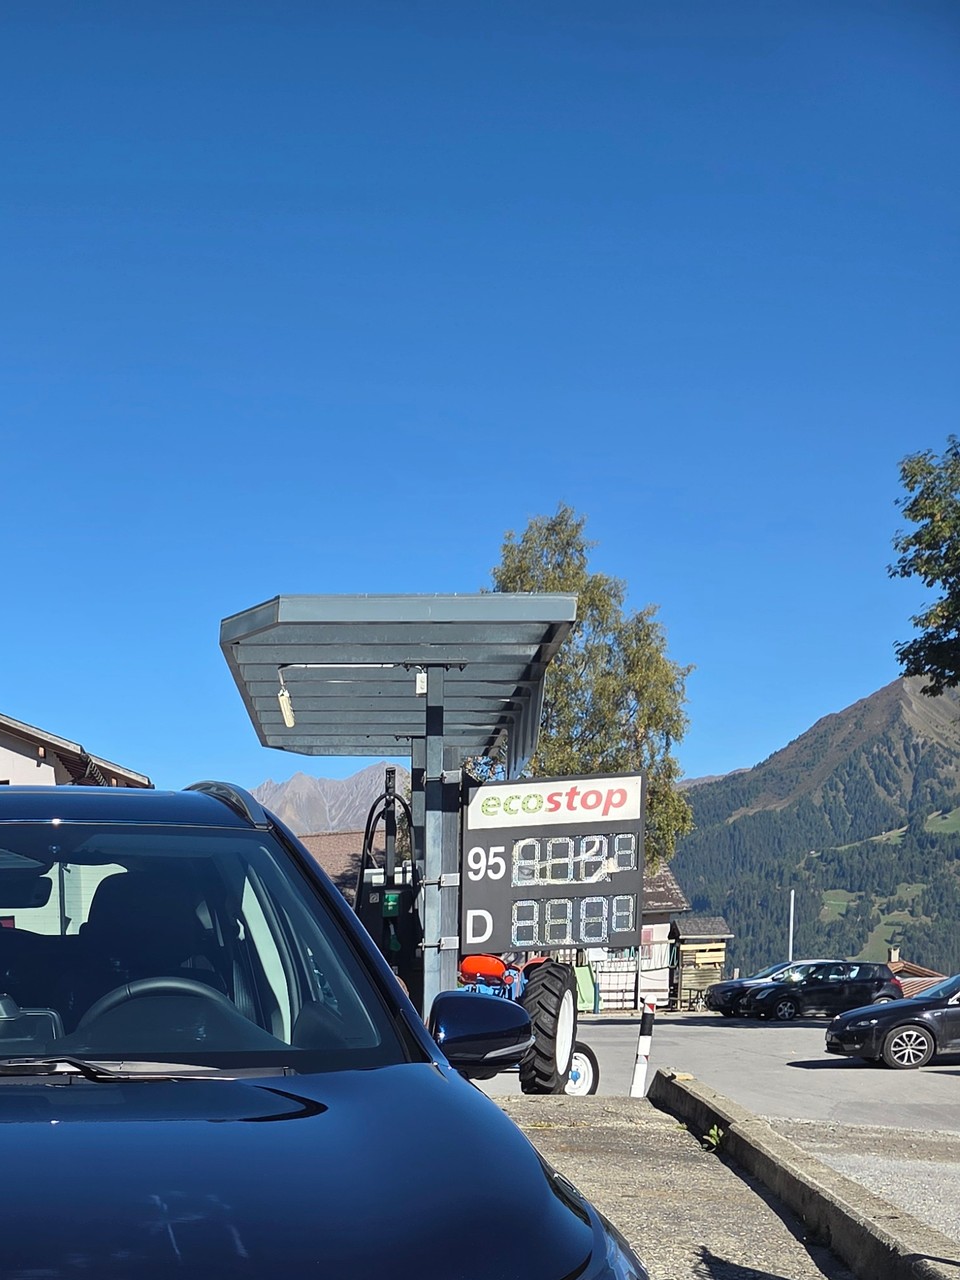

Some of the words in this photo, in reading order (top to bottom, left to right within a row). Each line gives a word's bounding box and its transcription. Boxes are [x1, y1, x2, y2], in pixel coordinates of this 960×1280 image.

[480, 785, 628, 817] ecostop
[467, 846, 506, 881] 95
[466, 909, 494, 944] D
